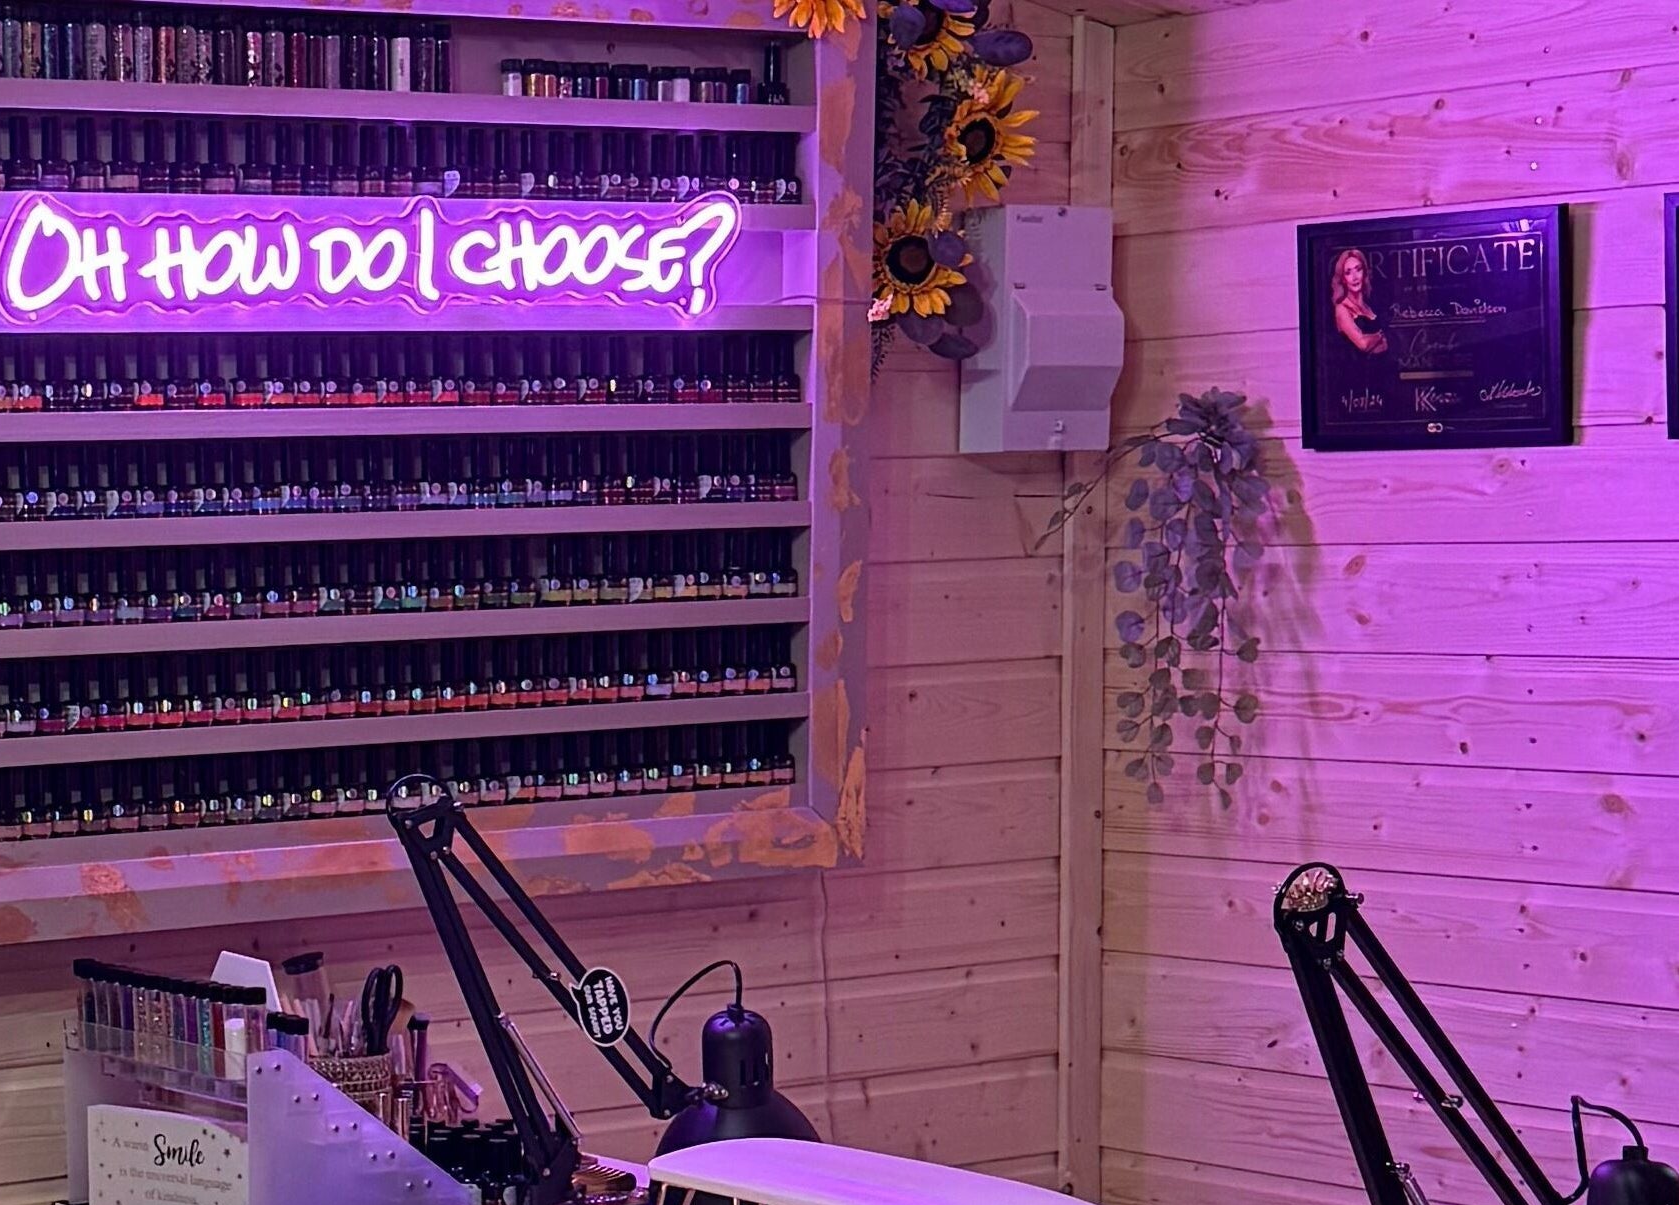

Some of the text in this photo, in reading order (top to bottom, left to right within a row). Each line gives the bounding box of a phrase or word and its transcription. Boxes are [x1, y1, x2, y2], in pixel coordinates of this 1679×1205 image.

[7, 203, 128, 312] OH
[138, 224, 300, 300] HOW
[312, 226, 407, 296] DO
[452, 203, 736, 316] CHOOSE?
[1328, 238, 1536, 282] RTIFICATE
[583, 985, 593, 1004] OUR
[593, 980, 613, 1034] TAPPED
[605, 976, 624, 1030] HAVE YOU
[153, 1133, 205, 1167] Smile
[129, 1167, 144, 1179] the
[190, 1175, 232, 1192] language
[144, 1189, 156, 1201] of
